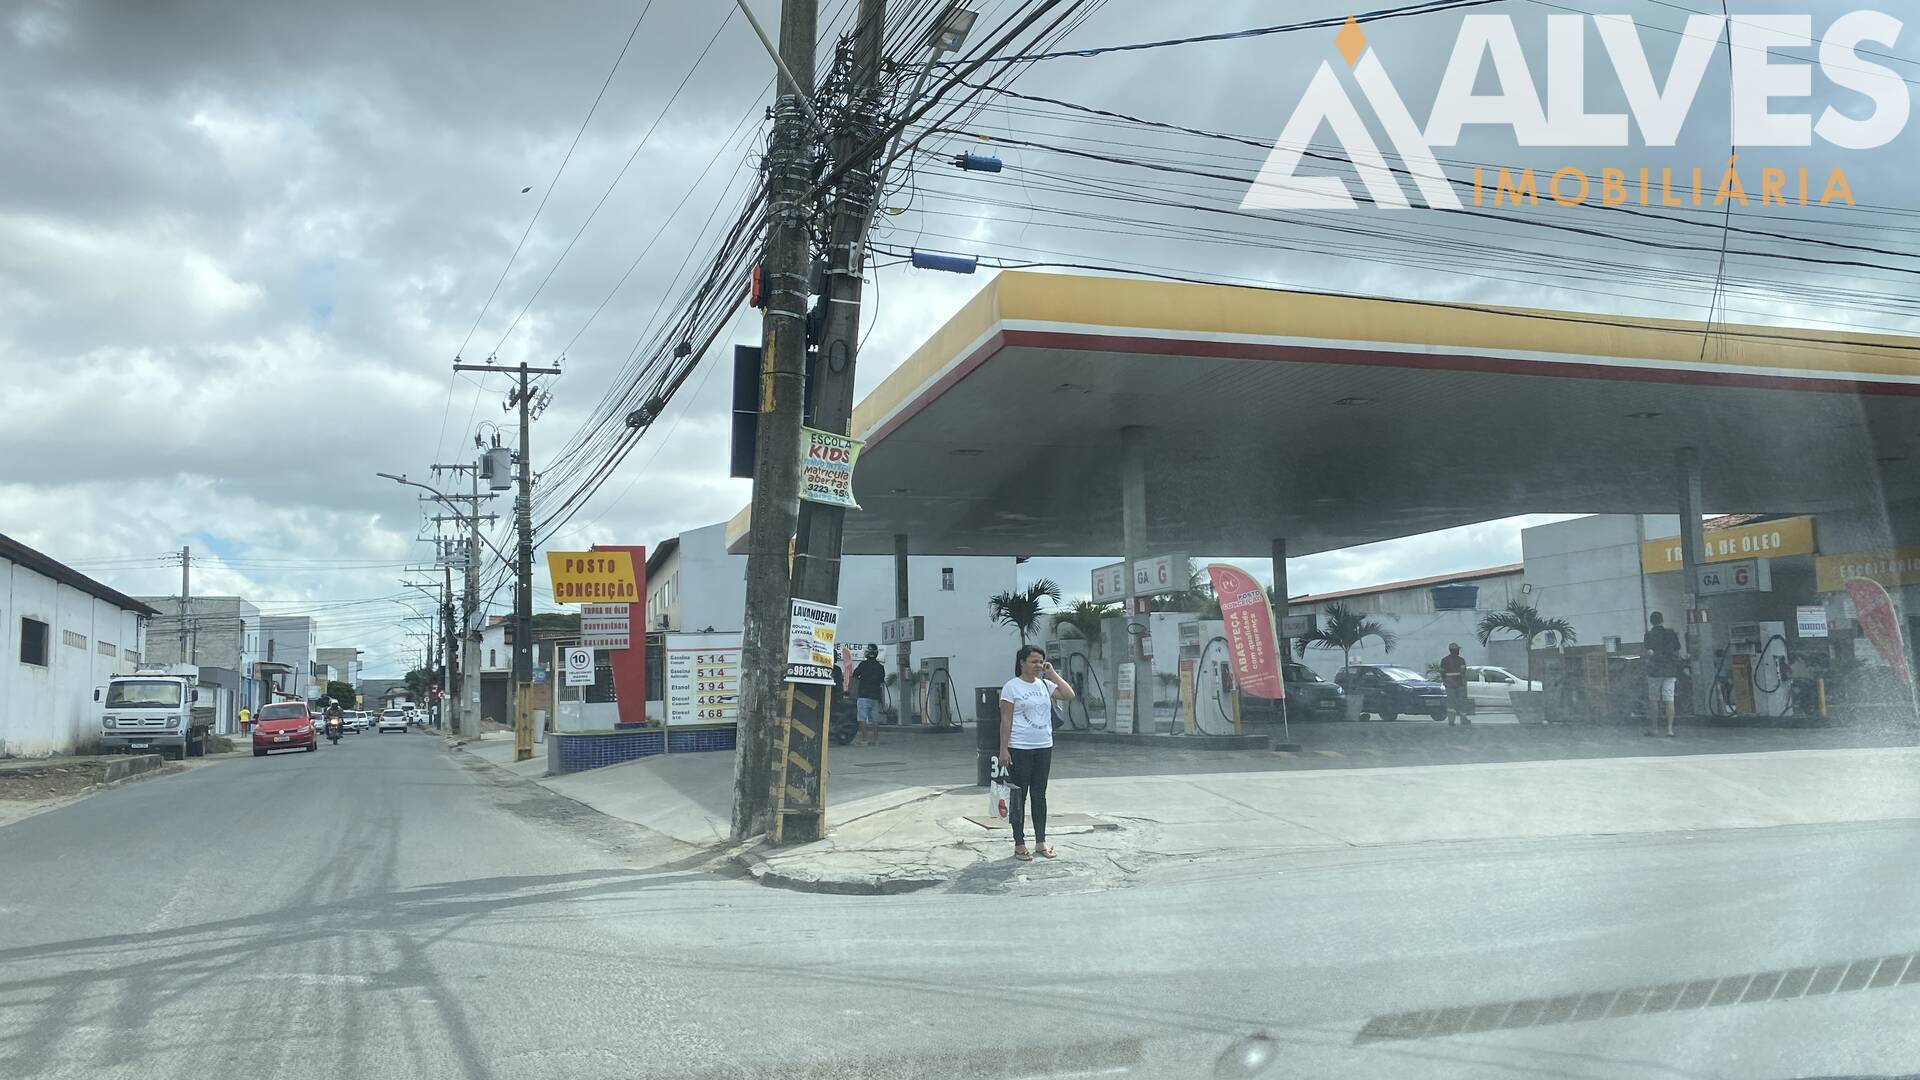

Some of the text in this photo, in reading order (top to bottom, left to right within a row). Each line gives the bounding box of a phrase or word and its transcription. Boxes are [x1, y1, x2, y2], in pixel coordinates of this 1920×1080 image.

[811, 433, 852, 449] ESCOLA
[809, 444, 850, 464] KIDS
[808, 474, 849, 490] abertas
[1719, 539, 1737, 555] DE
[566, 559, 615, 574] POSTO
[1158, 565, 1167, 584] G
[1114, 574, 1120, 592] E
[1137, 571, 1149, 585] GA
[1703, 574, 1720, 586] GA
[1736, 568, 1749, 586] G
[556, 579, 634, 600] CONCEIÇÃO
[1097, 578, 1104, 596] G
[1238, 590, 1261, 601] POSTO
[584, 606, 603, 615] TROCA
[605, 606, 612, 615] DE
[793, 605, 837, 625] LAVANDERIA
[1230, 611, 1249, 673] ABASTEÇA
[573, 654, 586, 664] 10
